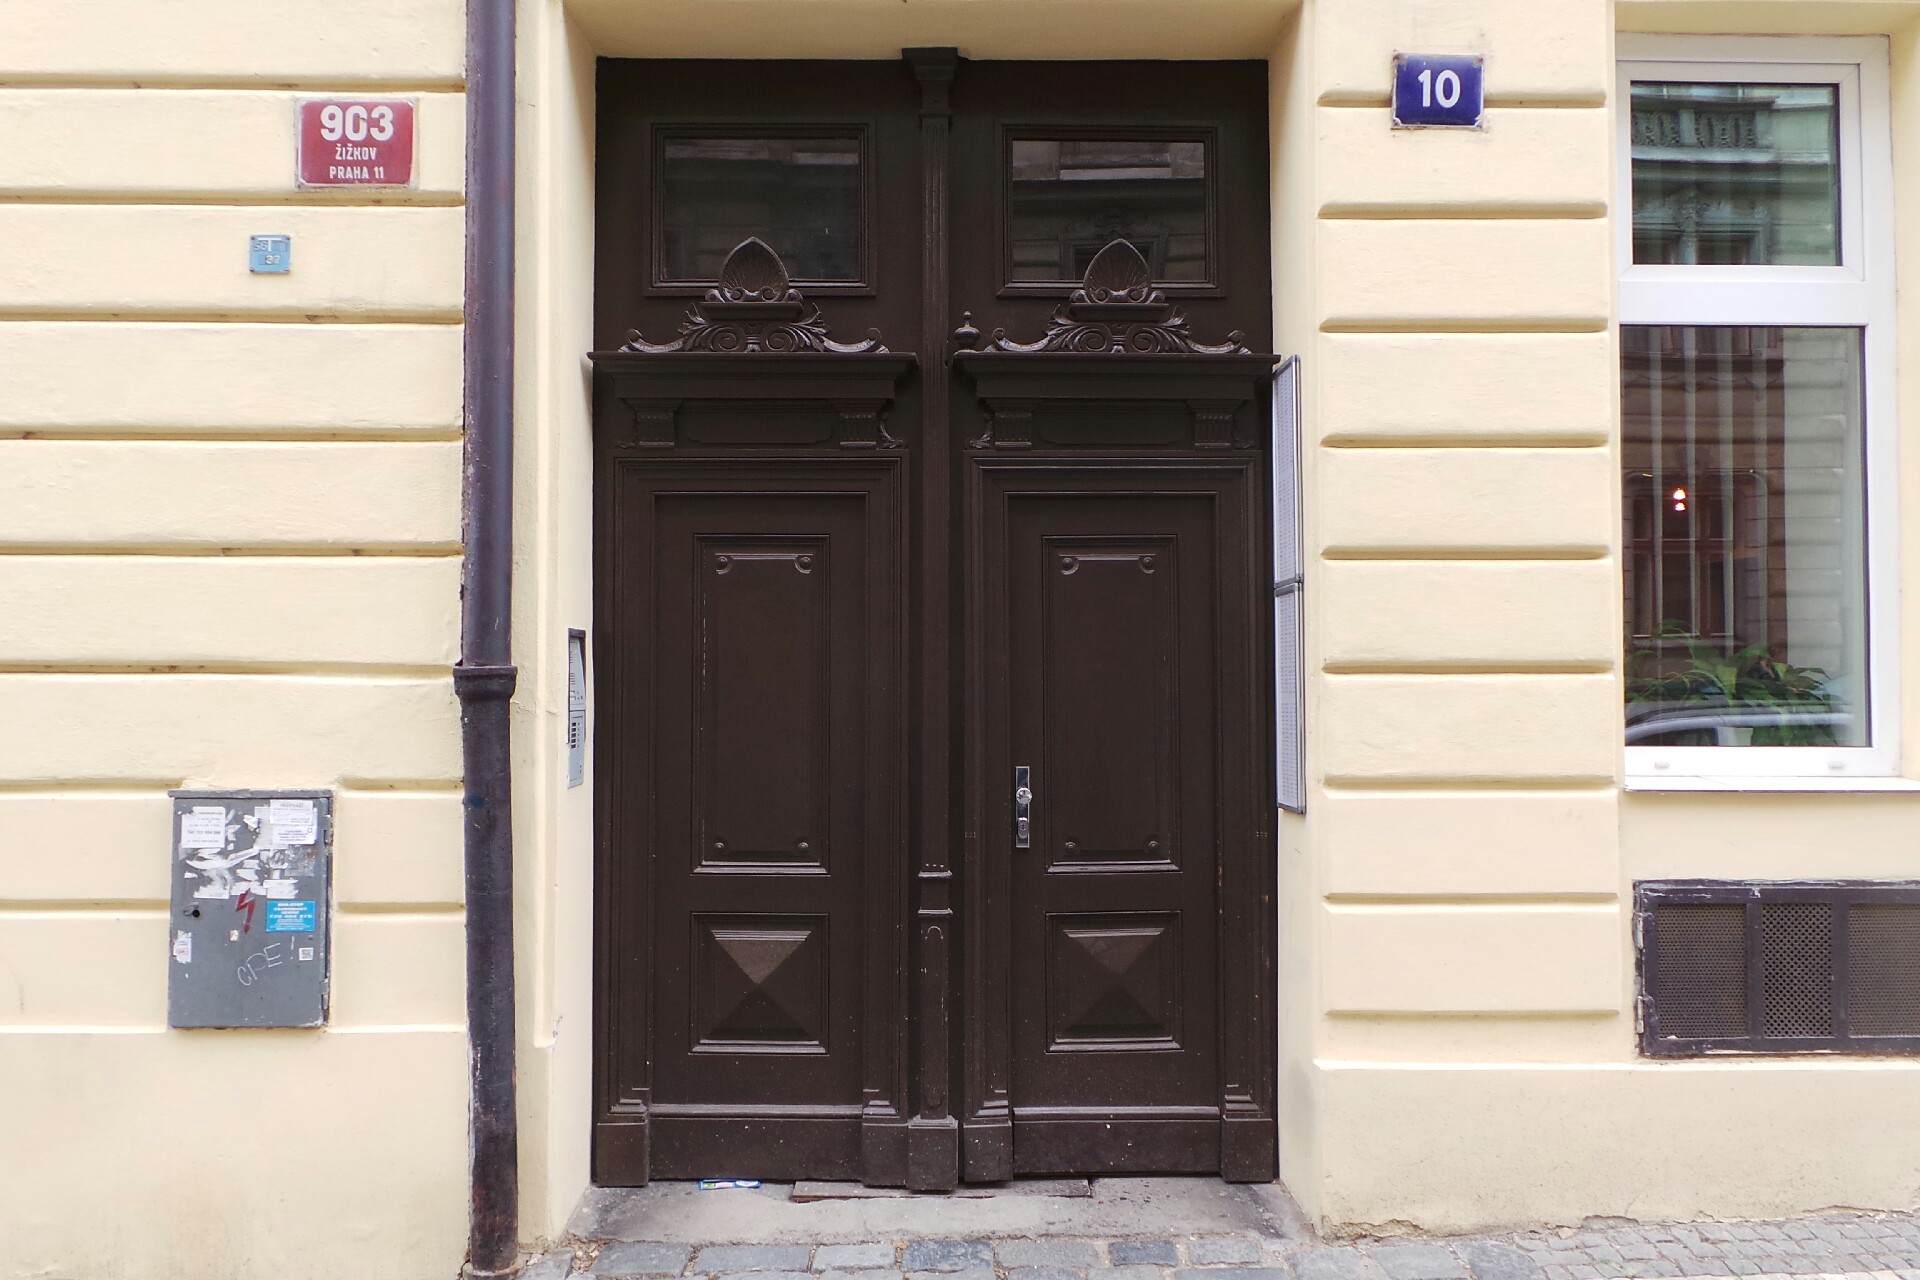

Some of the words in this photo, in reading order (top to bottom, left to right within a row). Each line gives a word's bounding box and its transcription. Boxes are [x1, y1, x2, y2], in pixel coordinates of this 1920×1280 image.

[1417, 69, 1461, 108] 10
[320, 105, 394, 141] 903
[335, 143, 377, 160] ŽIŽKOV
[329, 166, 369, 179] PRAHA
[373, 166, 384, 179] 11
